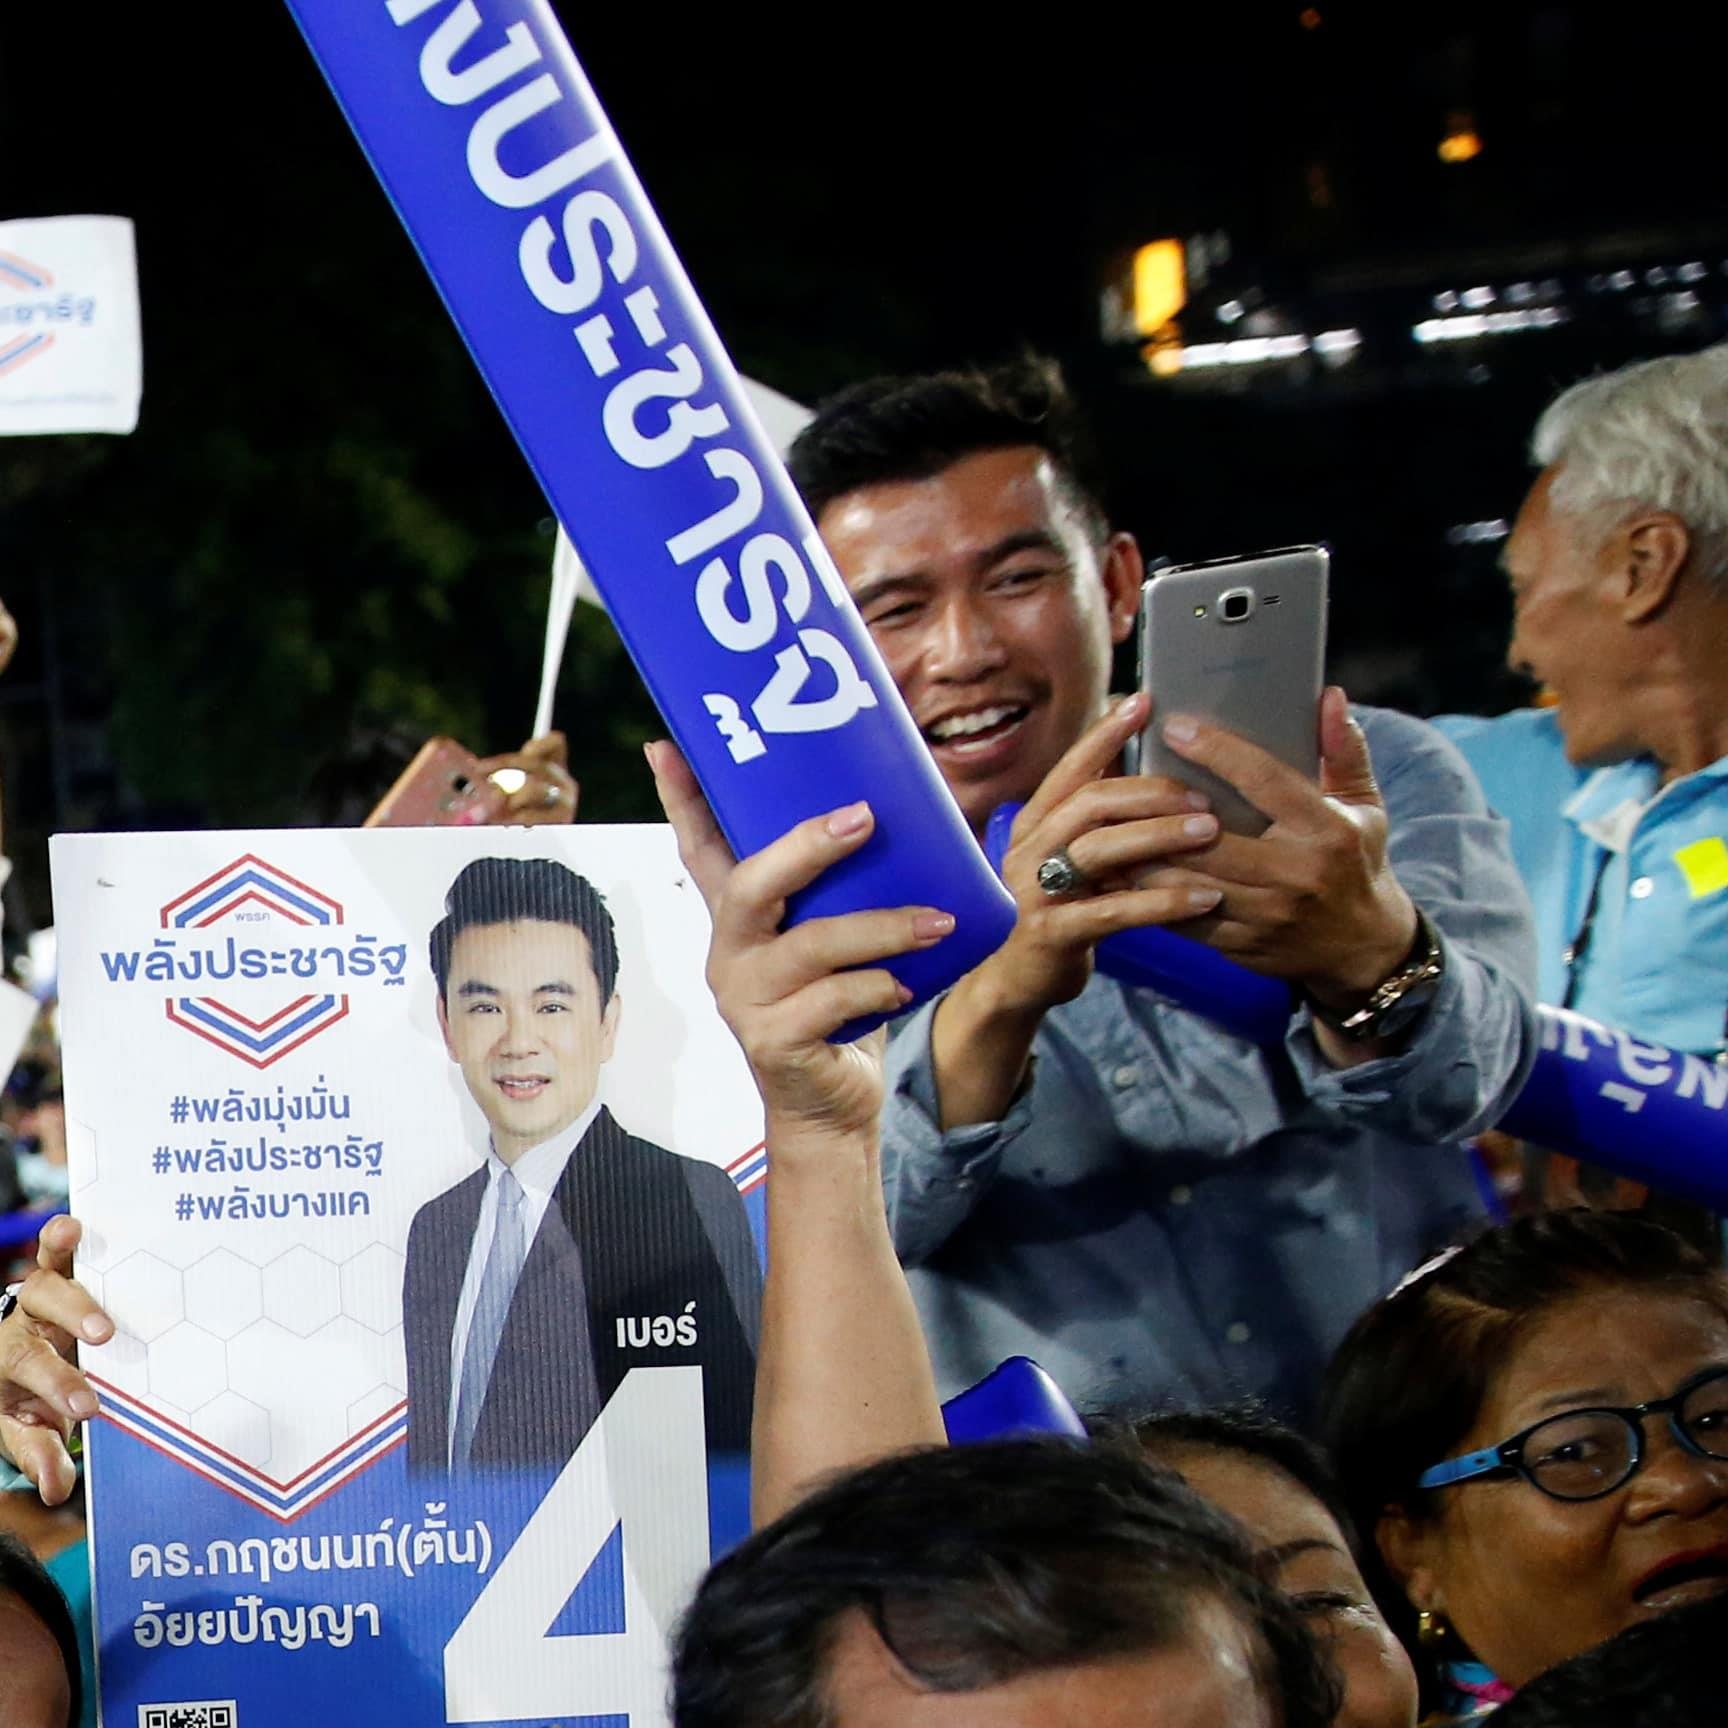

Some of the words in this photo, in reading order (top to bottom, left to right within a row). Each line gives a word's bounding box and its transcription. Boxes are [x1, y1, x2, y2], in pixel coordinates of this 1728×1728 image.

[386, 0, 880, 766] งประชารัฐ
[100, 934, 408, 987] พลังประชารัฐ
[170, 1075, 351, 1134] #พลังมุ่งมั่น
[151, 1135, 384, 1177] #พลังประชารัฐ
[175, 1185, 370, 1222] #พลังบางแค
[616, 1300, 698, 1349] เบอร์
[130, 1502, 493, 1583] ดร.กฤชนนท์(ตั้น)
[133, 1595, 381, 1651] อัยยปัญญา
